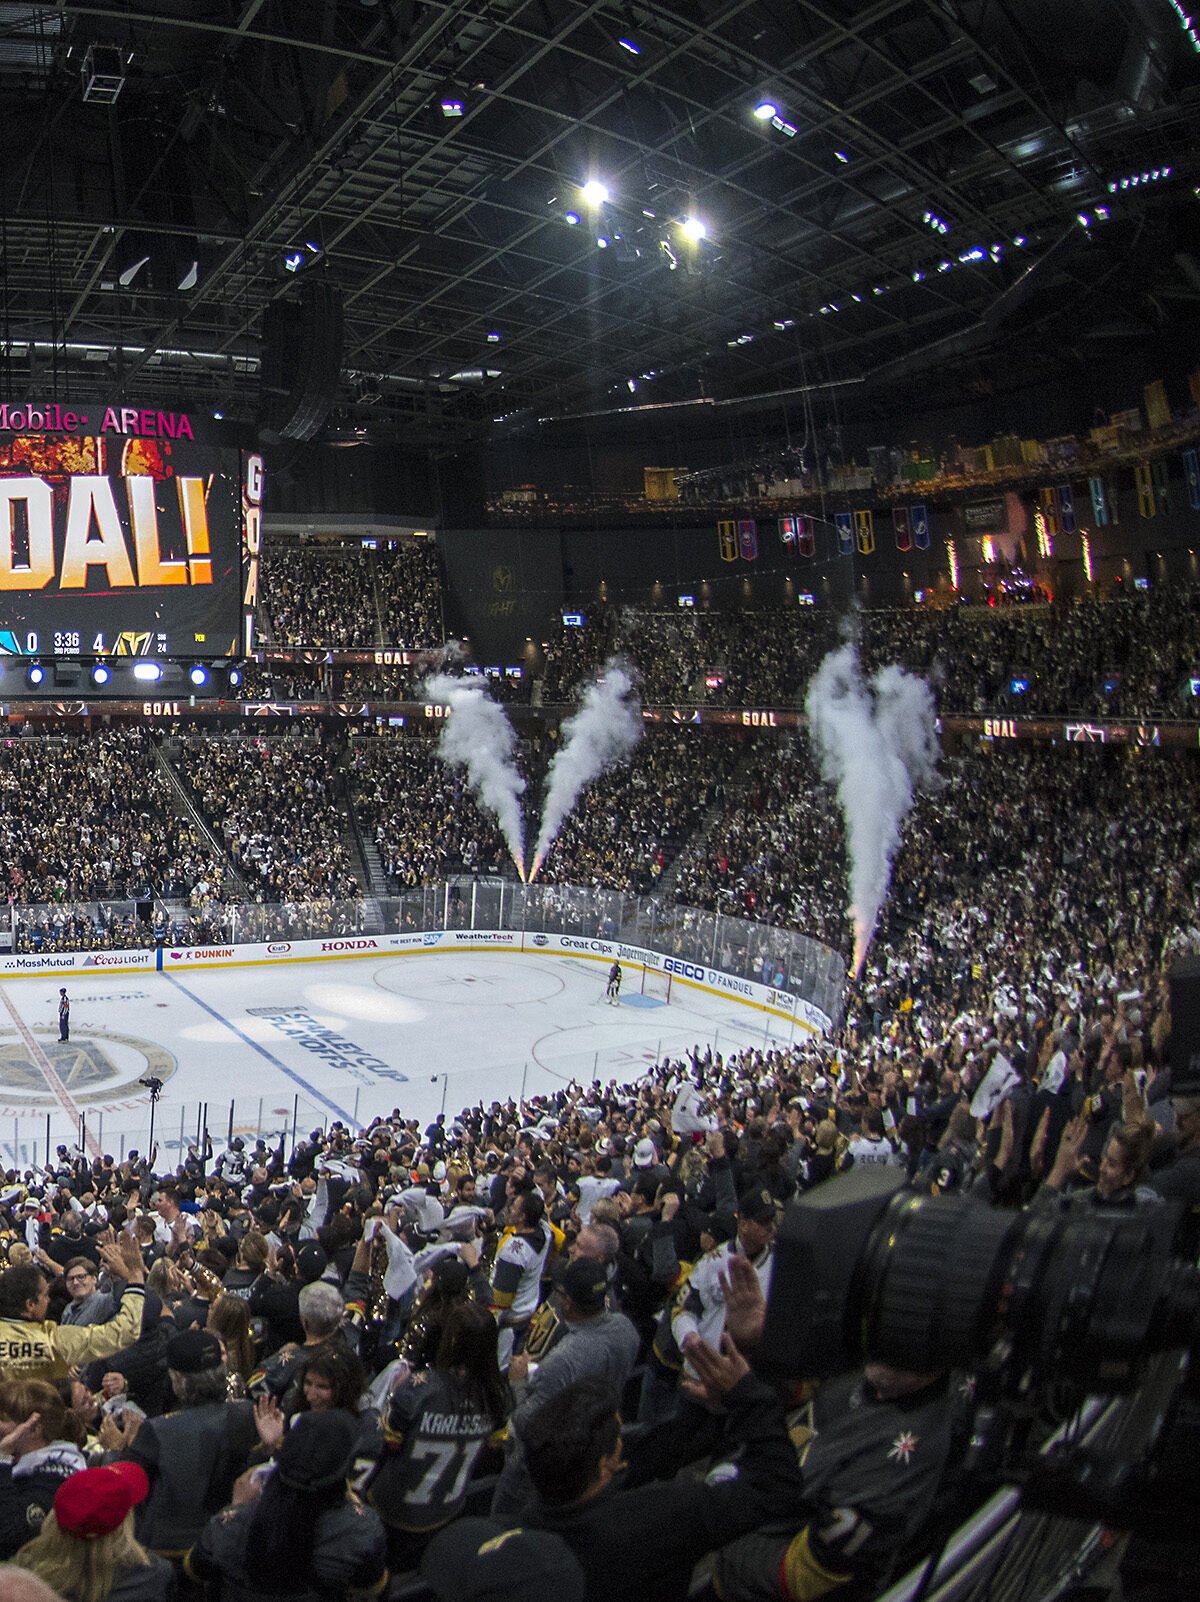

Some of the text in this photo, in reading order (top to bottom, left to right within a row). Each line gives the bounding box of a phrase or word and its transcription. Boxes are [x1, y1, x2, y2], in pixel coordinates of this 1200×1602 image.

[101, 407, 195, 440] ARENA
[26, 632, 38, 652] 0
[53, 632, 80, 648] 3:36
[92, 633, 104, 653] 4
[157, 642, 167, 652] 24
[374, 652, 411, 665] GOAL
[142, 702, 181, 717] GOAL
[424, 704, 451, 718] GOA
[742, 711, 777, 728] GOAL
[984, 719, 1017, 738] GOAL
[320, 939, 378, 952] HONDA
[423, 933, 440, 945] SAP
[455, 933, 514, 942] WeatherTech
[560, 936, 589, 950] Great
[590, 941, 612, 955] Clips
[194, 948, 235, 960] DUNKIN'
[270, 943, 287, 953] Kraft
[16, 956, 75, 969] MassMutual
[93, 953, 149, 967] Coors LIGHT
[663, 958, 704, 982] GEICO
[718, 974, 754, 997] FANDUEL
[262, 1015, 356, 1070] PLAYOFFS
[286, 1011, 409, 1083] STANLEY CUP
[404, 1439, 484, 1505] 71
